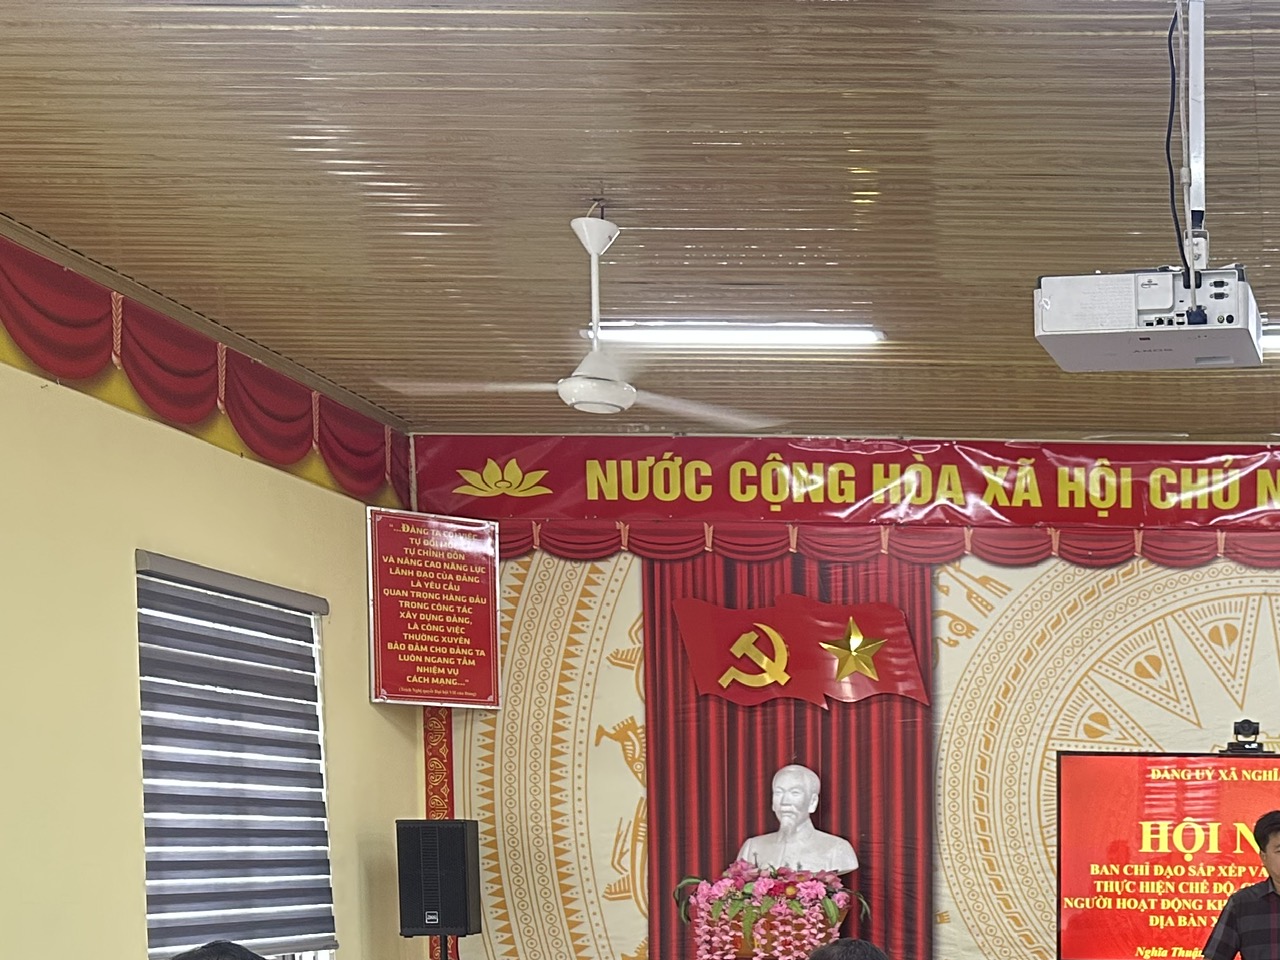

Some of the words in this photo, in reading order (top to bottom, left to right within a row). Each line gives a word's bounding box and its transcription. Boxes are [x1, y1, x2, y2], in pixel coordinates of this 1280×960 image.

[586, 452, 712, 502] NƯỚC
[729, 453, 856, 512] CỘNG
[872, 453, 965, 506] HÒA
[980, 458, 1042, 508] XÃ
[1057, 458, 1132, 517] HỘI
[1149, 457, 1241, 509] CHỦ
[404, 547, 416, 556] TỰ
[418, 548, 445, 558] CHỈNH
[397, 557, 422, 567] NÂNG
[389, 567, 414, 576] LÃNH
[416, 571, 434, 579] ĐẠO
[436, 571, 454, 580] CỦA
[456, 574, 480, 583] ĐẢNG
[424, 581, 440, 589] YÊU
[443, 583, 460, 591] CẦU
[383, 588, 408, 597] QUAN
[411, 591, 440, 600] TRỌNG
[443, 594, 466, 602] HÀNG
[469, 595, 486, 604] ĐẦU
[399, 600, 429, 610] TRONG
[431, 602, 454, 612] CÔNG
[456, 606, 473, 614] TÁC
[400, 611, 417, 620] XÂY
[420, 613, 444, 622] DỰNG
[421, 623, 444, 632] CÔNG
[446, 626, 465, 634] VIỆC
[403, 632, 440, 642] THƯỜNG
[441, 636, 470, 645] XUYÊN
[388, 642, 406, 650] BẢO
[408, 643, 428, 652] ĐẢM
[449, 646, 473, 656] ĐẢNG
[424, 656, 455, 665] NGANG
[457, 656, 476, 666] TẦM
[416, 666, 445, 674] NHIỆM
[407, 674, 429, 683] CÁCH
[1151, 766, 1191, 780] ĐẢNG
[1218, 767, 1238, 780] XÃ
[1138, 817, 1222, 862] HỘI
[1090, 864, 1120, 876] BAN
[1123, 862, 1150, 876] CHỈ
[1154, 864, 1185, 878] ĐẠO
[1188, 862, 1216, 877] SẮP
[1218, 863, 1247, 877] XẾP
[1094, 879, 1136, 896] THỰC
[1140, 879, 1175, 896] HIỆN
[1178, 879, 1209, 894] CHẾ
[1064, 896, 1112, 909] NGƯỜI
[1116, 899, 1157, 912] HOẠT
[1160, 897, 1203, 912] ĐỘNG
[1149, 915, 1175, 929] ĐỊA
[1178, 913, 1207, 926] BÀN
[1135, 946, 1168, 959] Nghĩa
[1171, 946, 1204, 959] Thuậ
